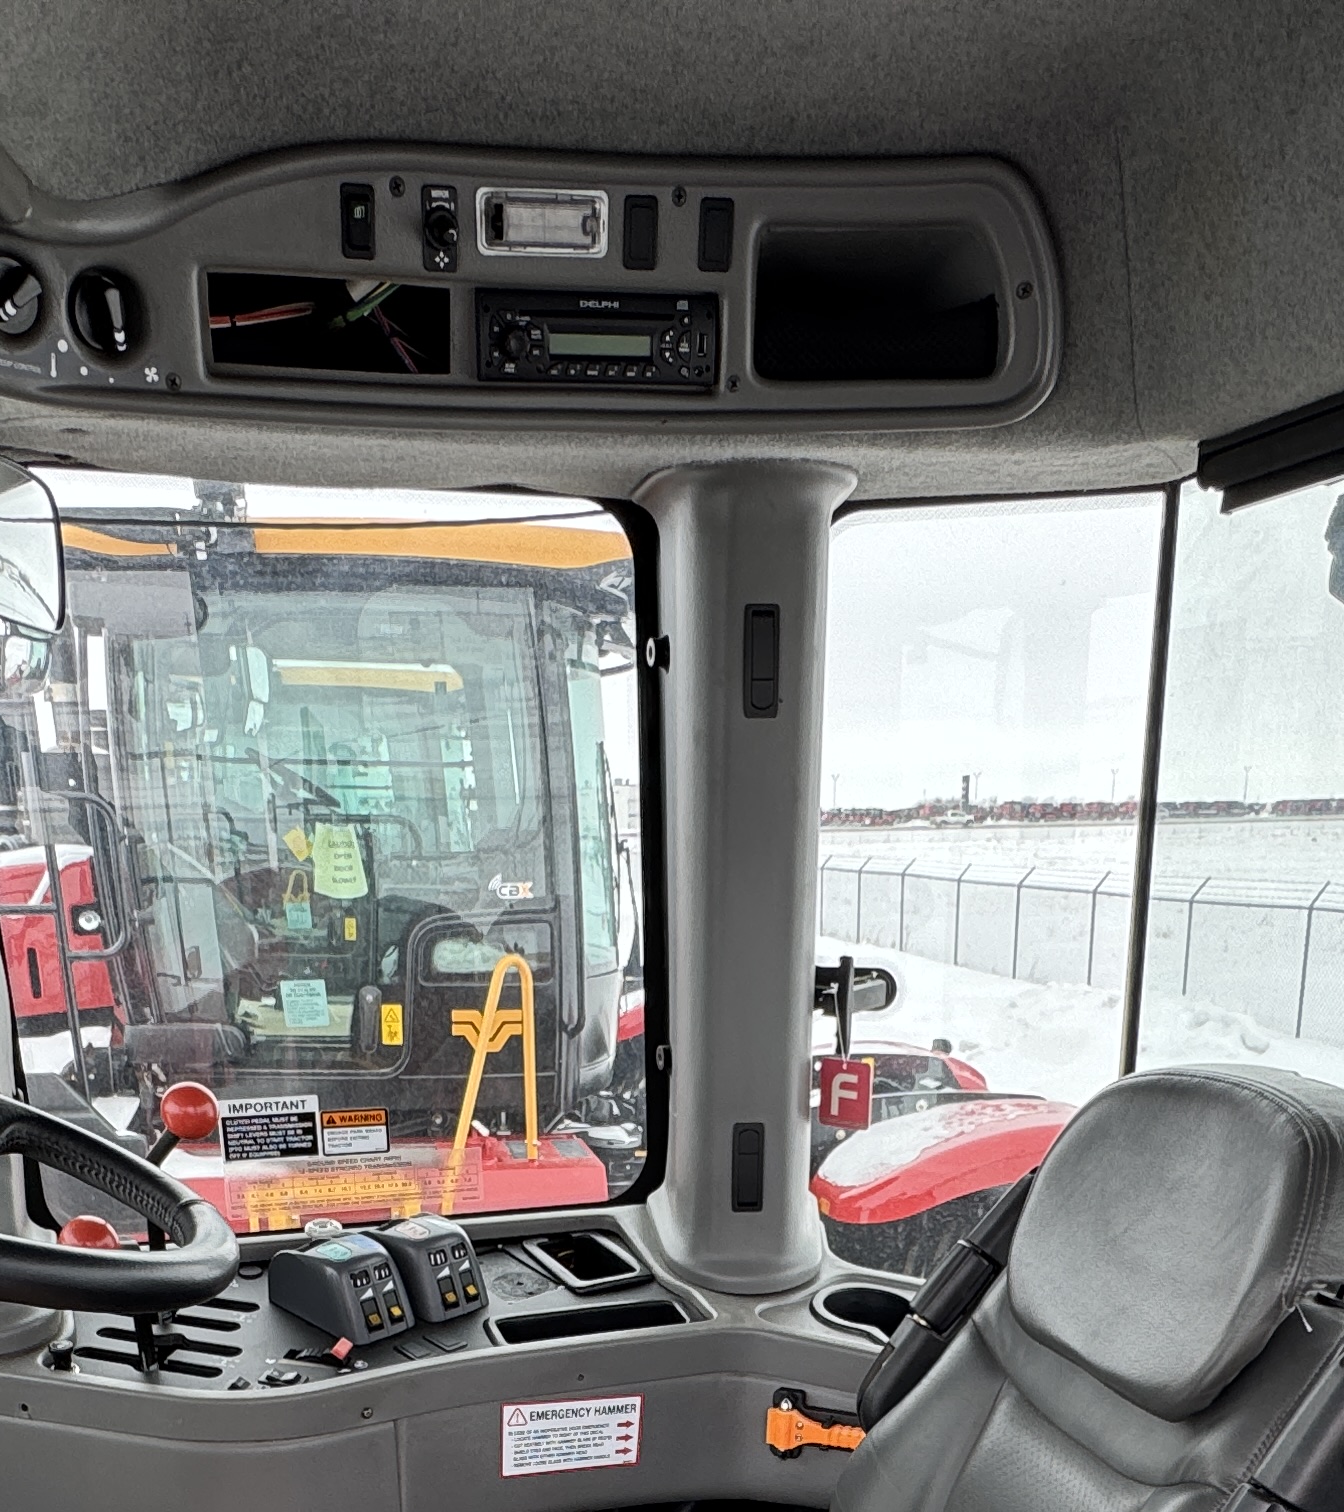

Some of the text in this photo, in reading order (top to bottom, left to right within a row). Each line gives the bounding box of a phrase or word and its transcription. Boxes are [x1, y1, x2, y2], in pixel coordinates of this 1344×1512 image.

[579, 300, 619, 309] DELPHI
[830, 1073, 858, 1116] F
[227, 1099, 307, 1115] IMPORTANT
[339, 1113, 382, 1123] WARNING
[530, 1404, 636, 1421] EMERGENCY HAMMER
